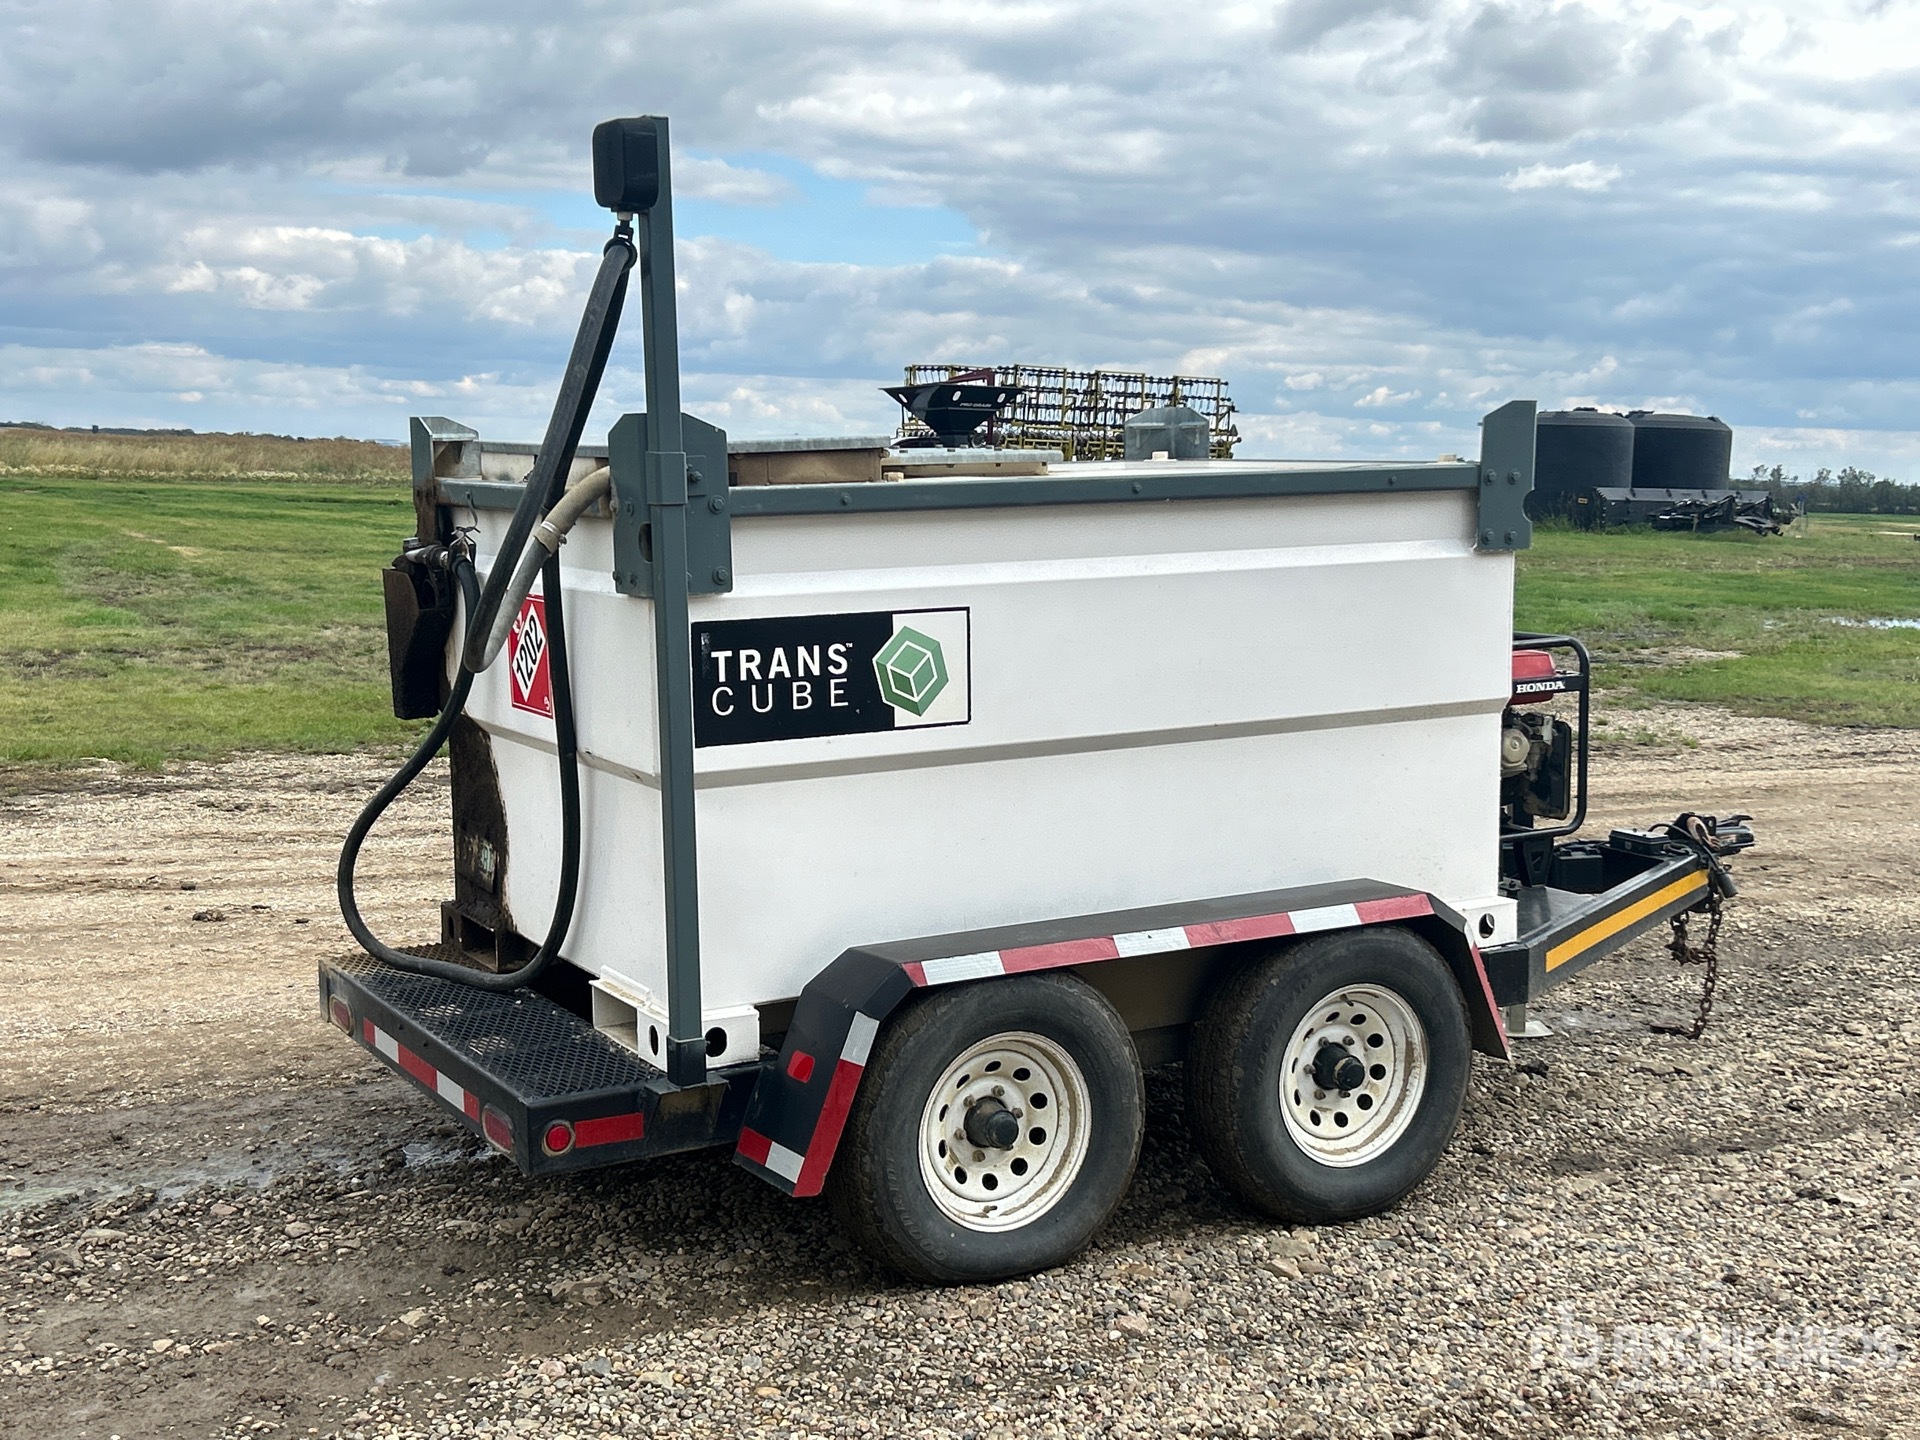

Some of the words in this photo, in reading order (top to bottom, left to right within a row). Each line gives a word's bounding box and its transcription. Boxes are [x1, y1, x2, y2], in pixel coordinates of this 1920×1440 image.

[515, 614, 543, 690] 1202
[711, 677, 849, 716] CUBE
[1516, 680, 1566, 694] HONDA
